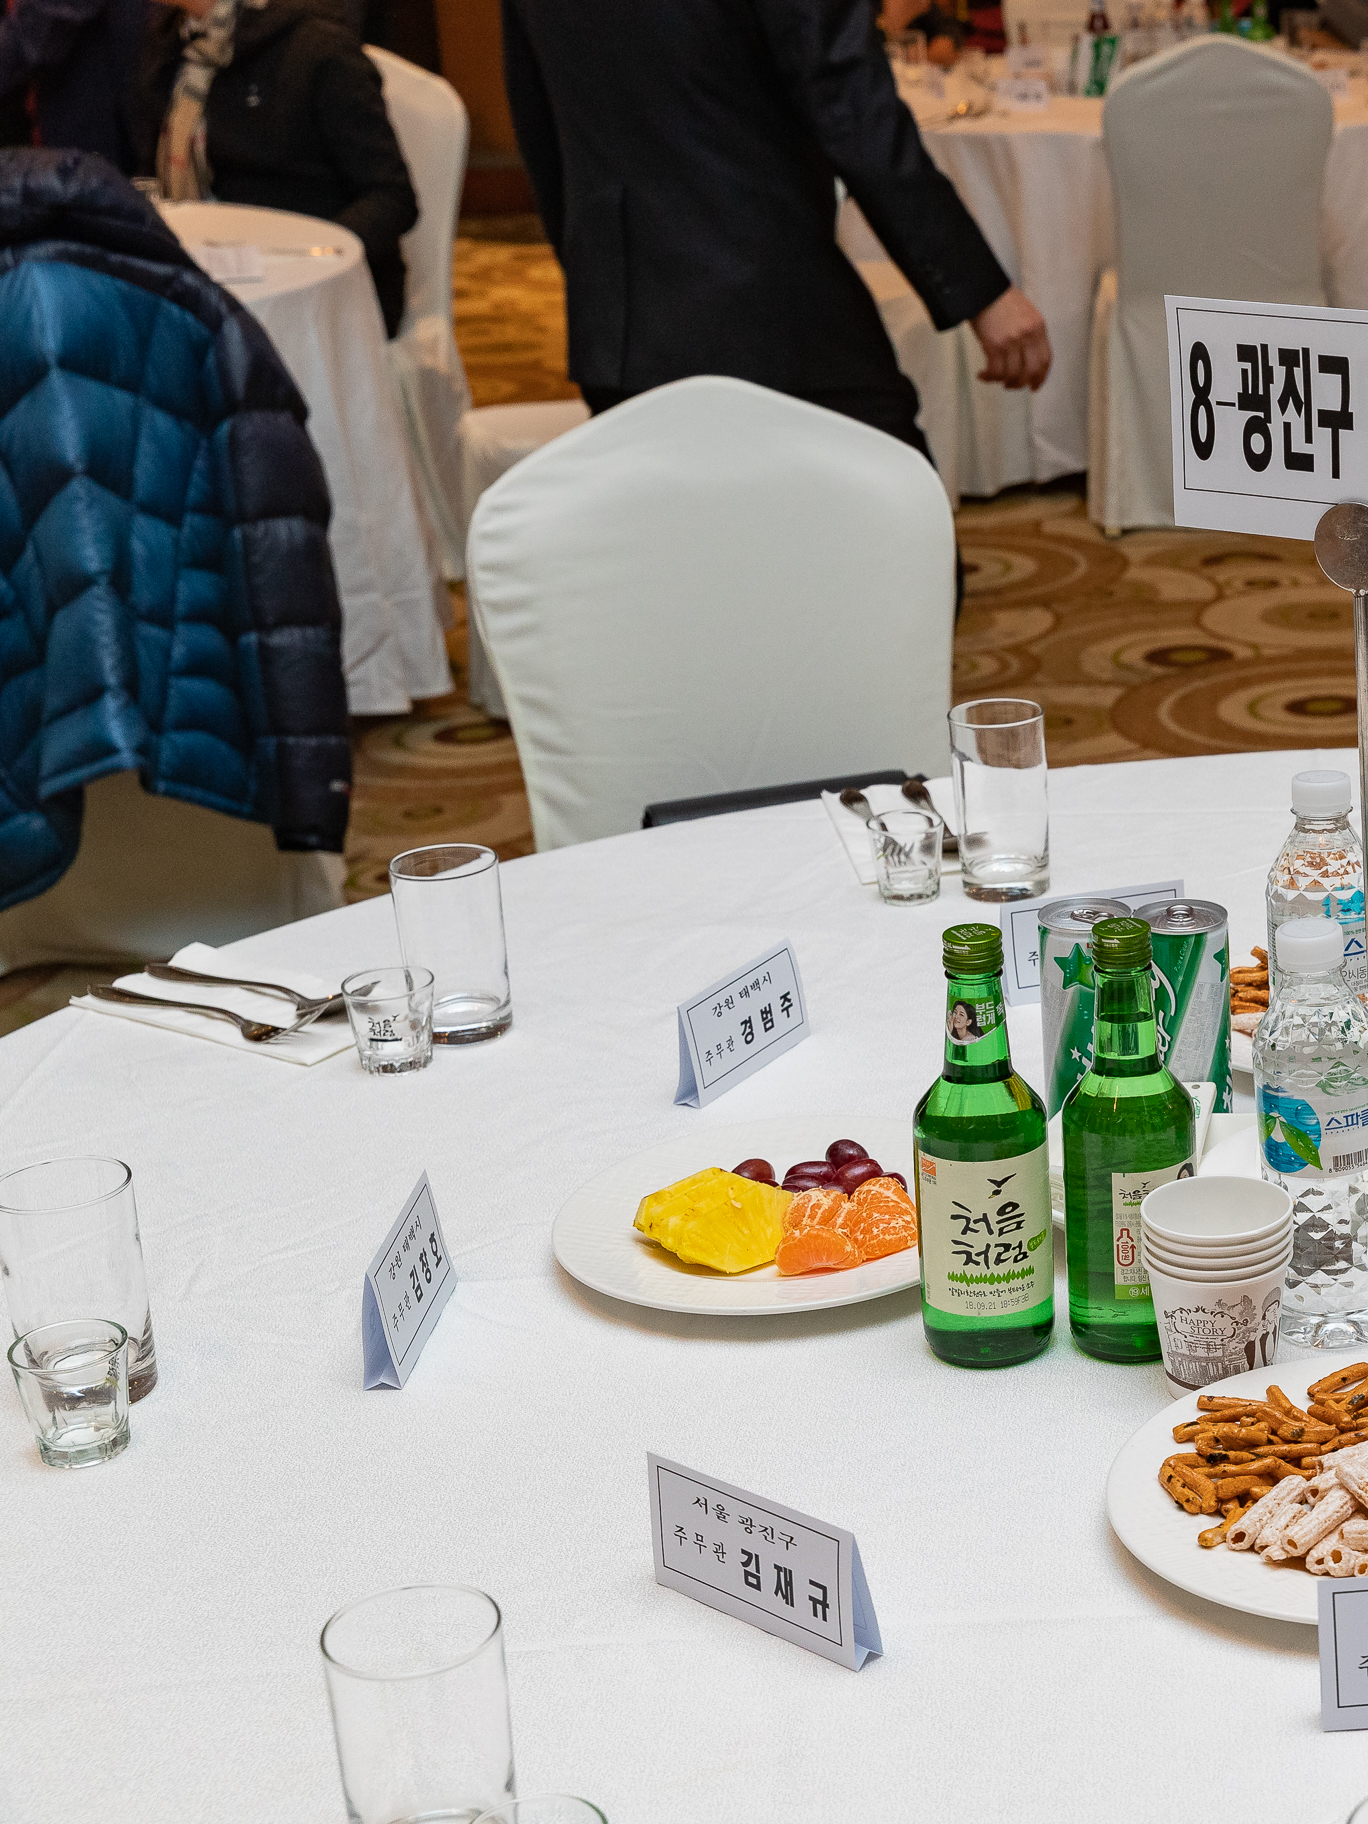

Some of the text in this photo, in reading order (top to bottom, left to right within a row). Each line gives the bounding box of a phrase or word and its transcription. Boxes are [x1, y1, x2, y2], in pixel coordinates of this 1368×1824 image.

[1189, 340, 1354, 480] 8-광진구
[711, 971, 773, 1018] 강원 태백시
[704, 991, 794, 1067] 주무관 경범주
[950, 1201, 1026, 1238] 처음
[388, 1250, 403, 1281] 강원
[951, 1240, 1029, 1270] 처럼
[392, 1231, 443, 1333] 주무관 김창호
[965, 1300, 997, 1311] 18.09.21
[1179, 1315, 1217, 1328] HAPPY
[1189, 1326, 1228, 1335] STORY
[692, 1496, 798, 1551] 서울 광진구
[673, 1524, 830, 1623] 주무관 김재규
